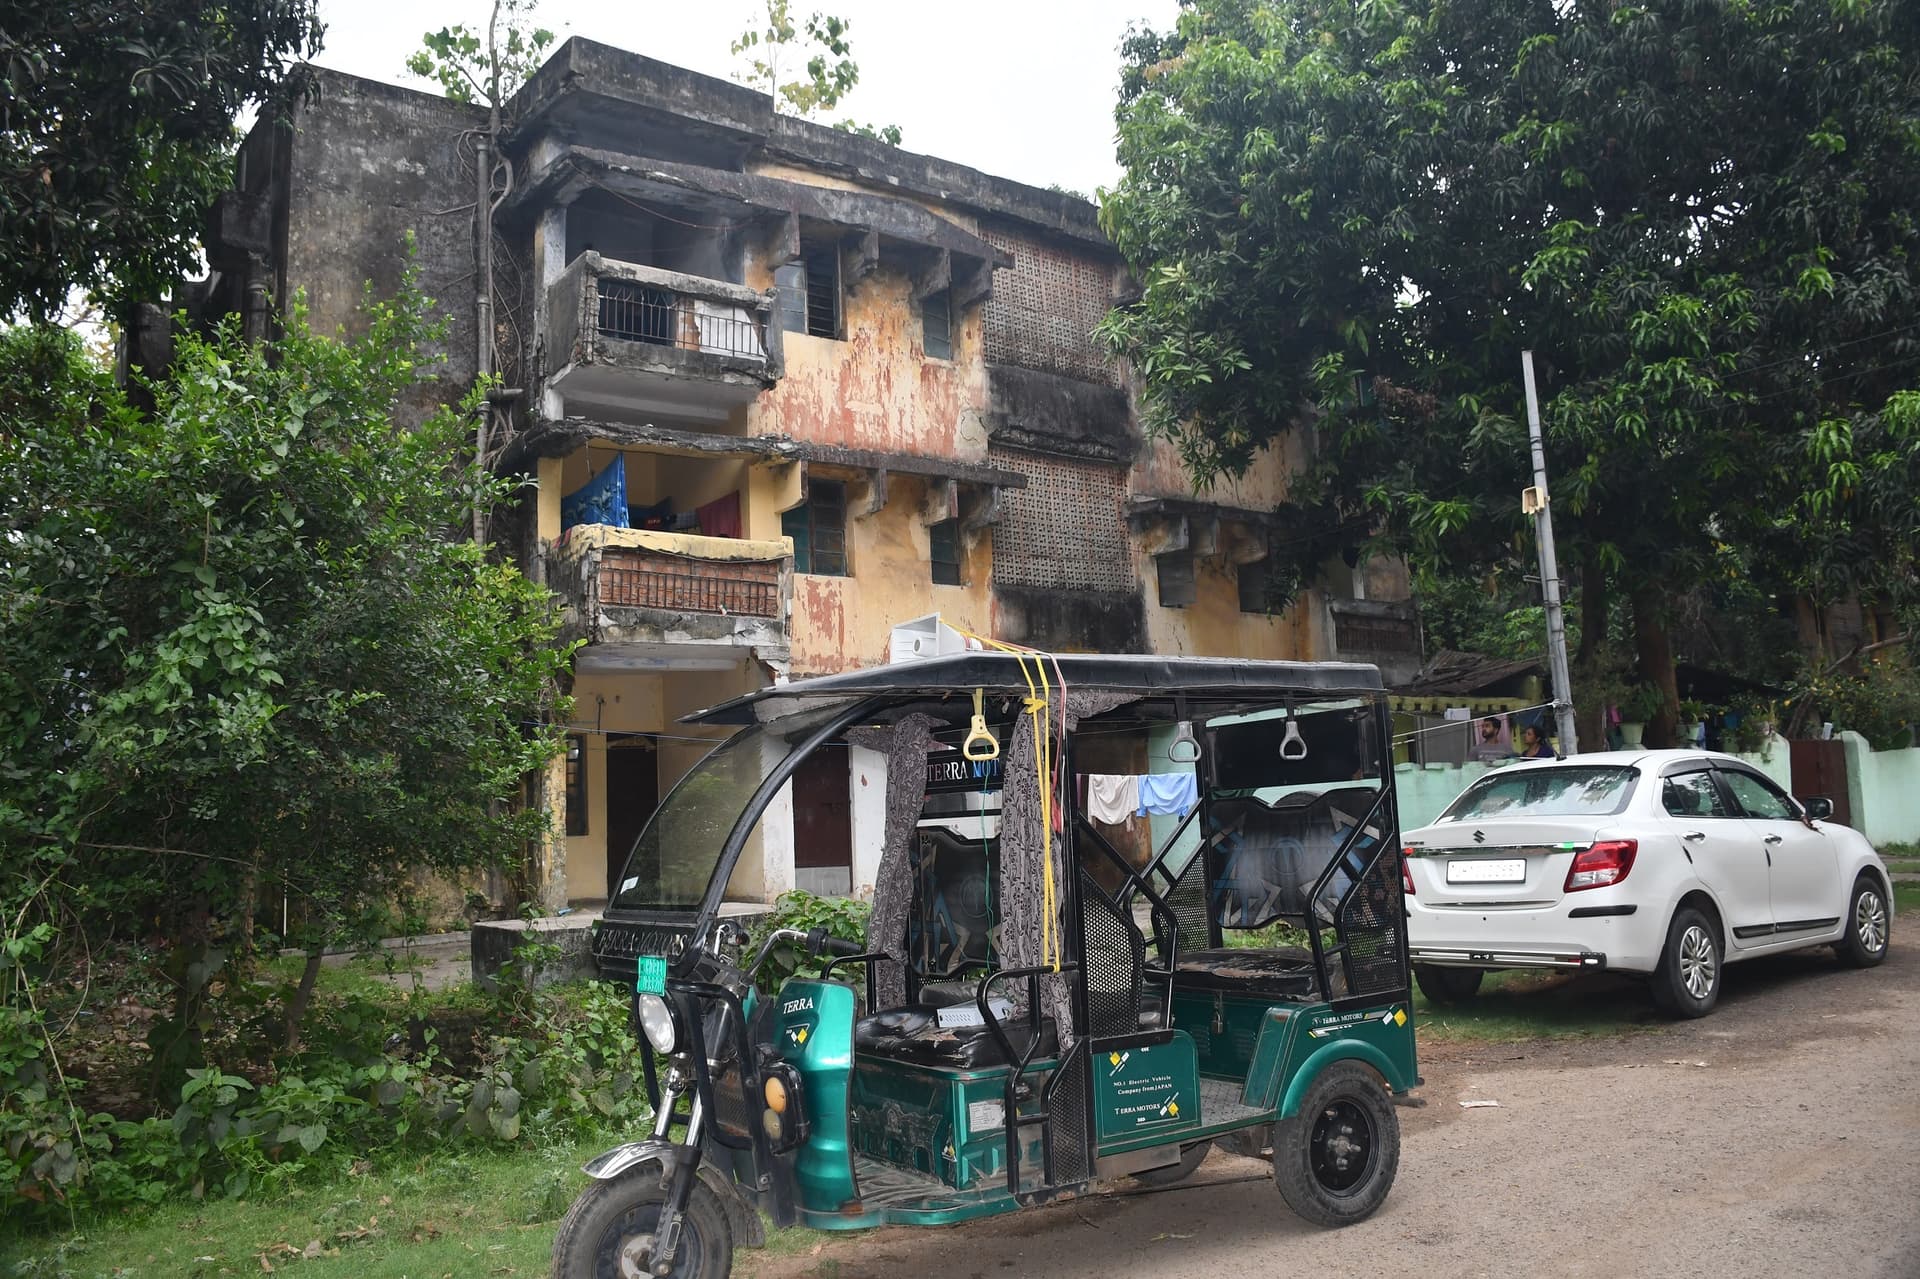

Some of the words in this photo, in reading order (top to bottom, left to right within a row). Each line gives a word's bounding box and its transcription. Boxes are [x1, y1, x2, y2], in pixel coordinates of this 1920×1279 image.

[926, 760, 968, 782] TERRA
[783, 996, 814, 1014] TERRA
[1322, 1015, 1340, 1025] TERRA
[1340, 1012, 1363, 1022] MOTORS
[1117, 1087, 1141, 1095] Company
[1154, 1083, 1172, 1091] JAPAN
[1136, 1103, 1161, 1112] MOTORS
